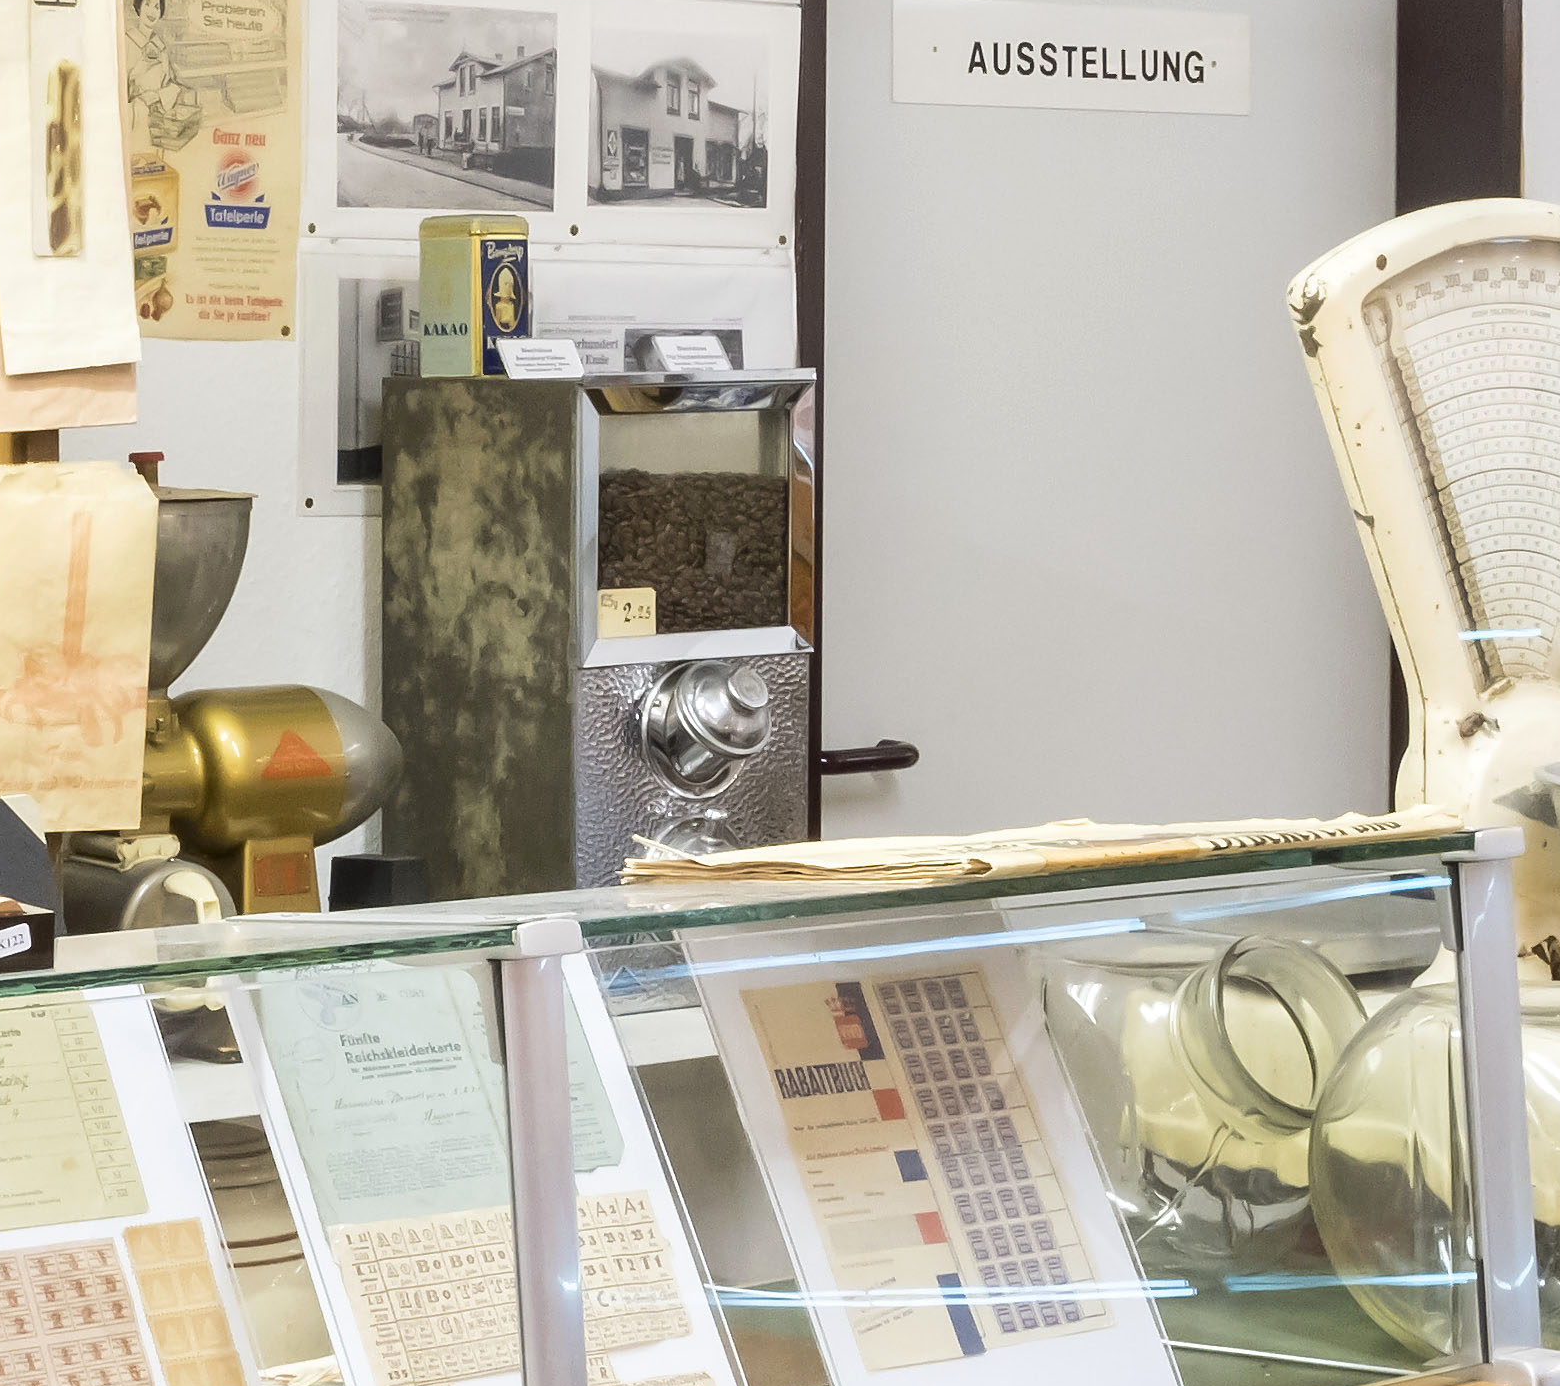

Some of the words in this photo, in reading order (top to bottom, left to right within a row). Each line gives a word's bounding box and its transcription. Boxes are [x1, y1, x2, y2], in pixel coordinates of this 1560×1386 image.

[201, 1, 266, 17] Probieren
[203, 15, 224, 29] Sie
[968, 41, 1205, 84] AUSSTELLUNG
[245, 130, 266, 147] neu
[209, 206, 265, 225] Tafelperle
[423, 322, 468, 337] KAKAO
[340, 1033, 380, 1046] Fünfte
[345, 1043, 461, 1064] Reichskleiderkarte
[774, 1061, 872, 1099] RABATTBUCH
